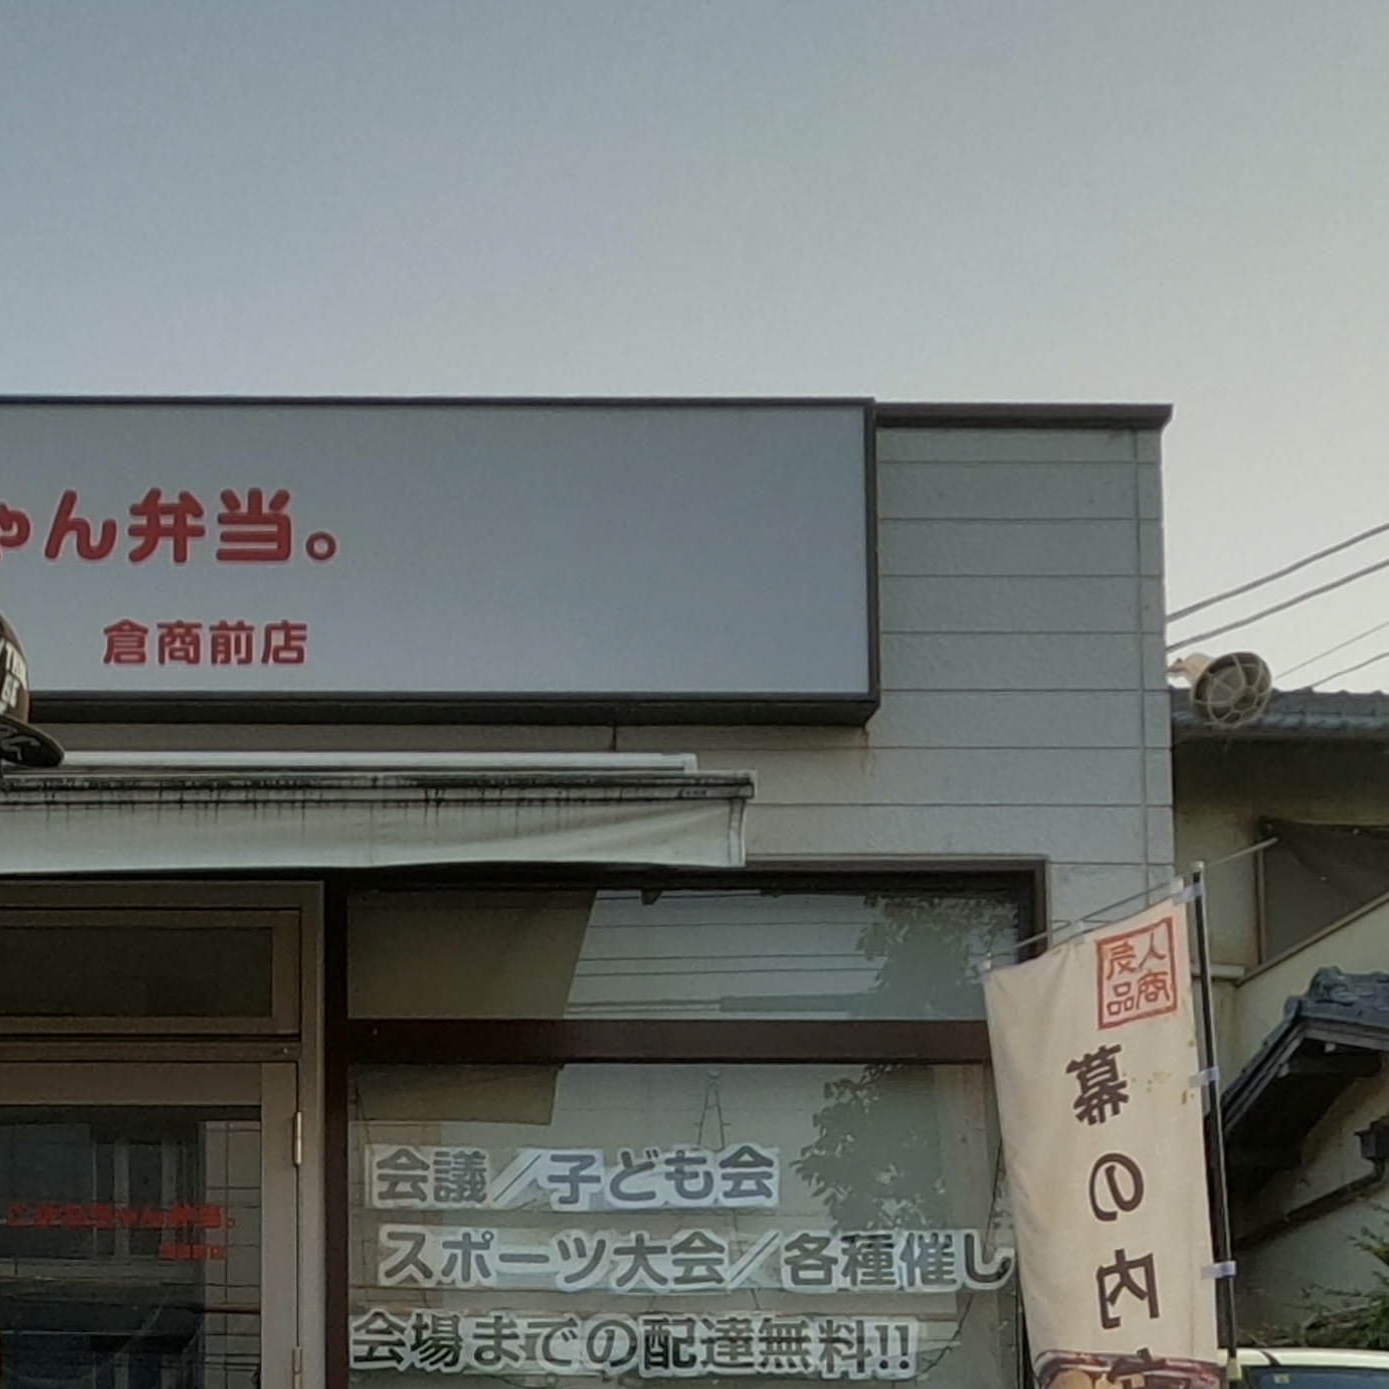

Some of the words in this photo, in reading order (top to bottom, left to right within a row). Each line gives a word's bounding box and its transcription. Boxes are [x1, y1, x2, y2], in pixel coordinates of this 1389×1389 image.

[102, 619, 308, 666] 倉商前店
[1, 671, 20, 709] BE
